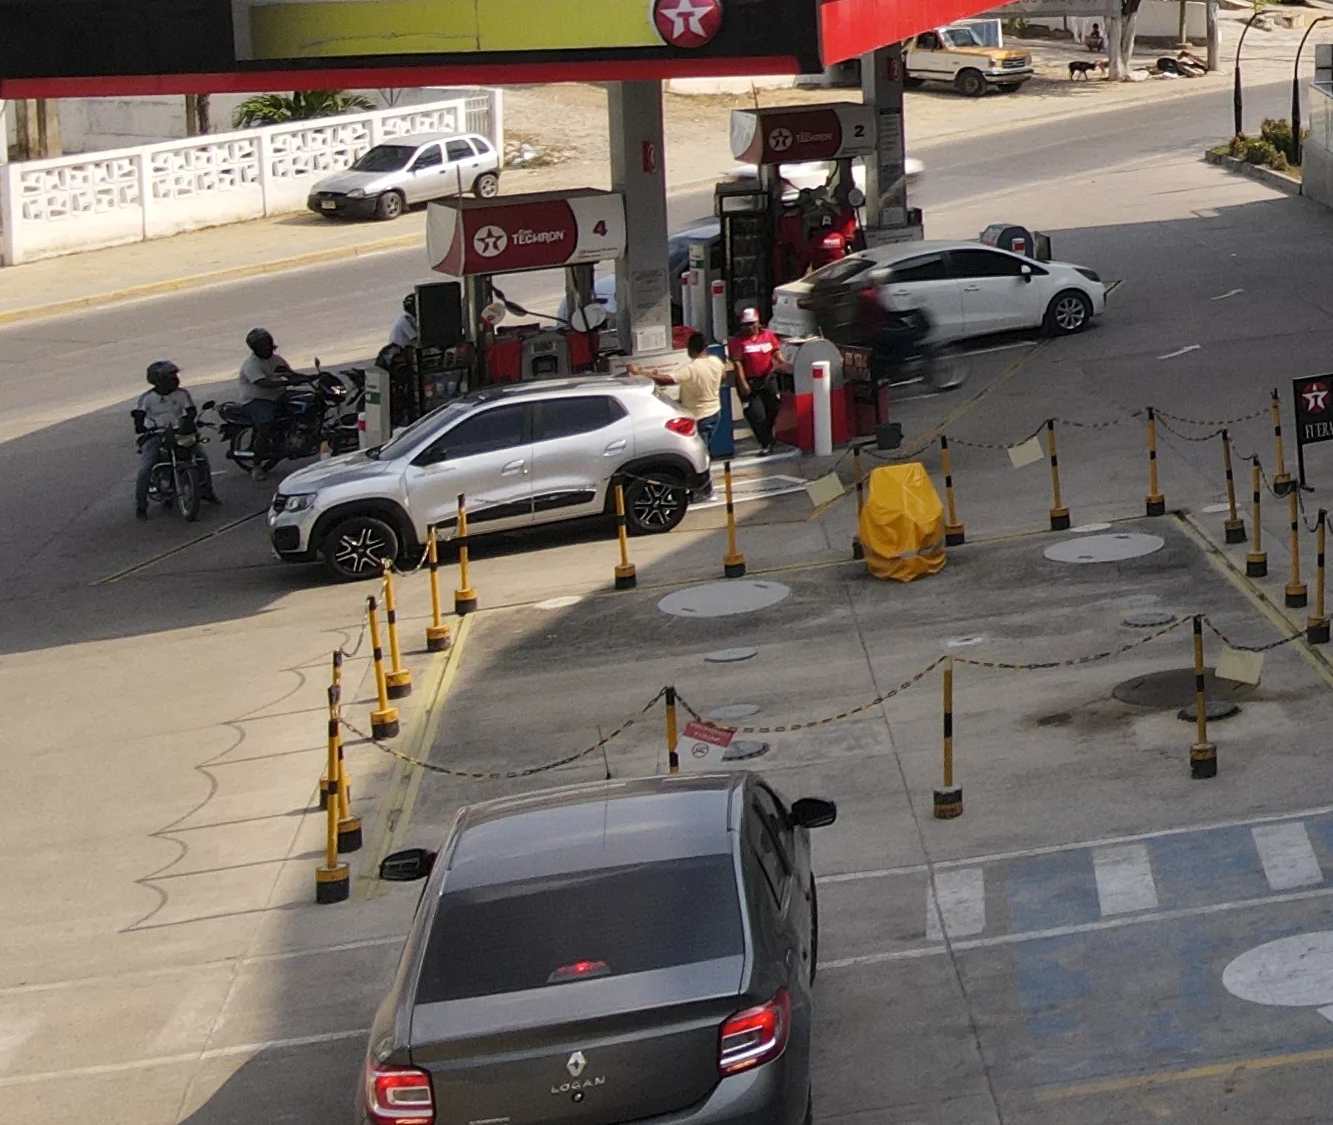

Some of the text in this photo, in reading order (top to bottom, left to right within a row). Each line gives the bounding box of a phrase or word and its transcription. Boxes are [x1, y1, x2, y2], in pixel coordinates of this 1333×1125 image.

[854, 125, 865, 138] 2
[512, 220, 608, 245] TECHRON 4
[551, 1076, 605, 1093] LOGAN
